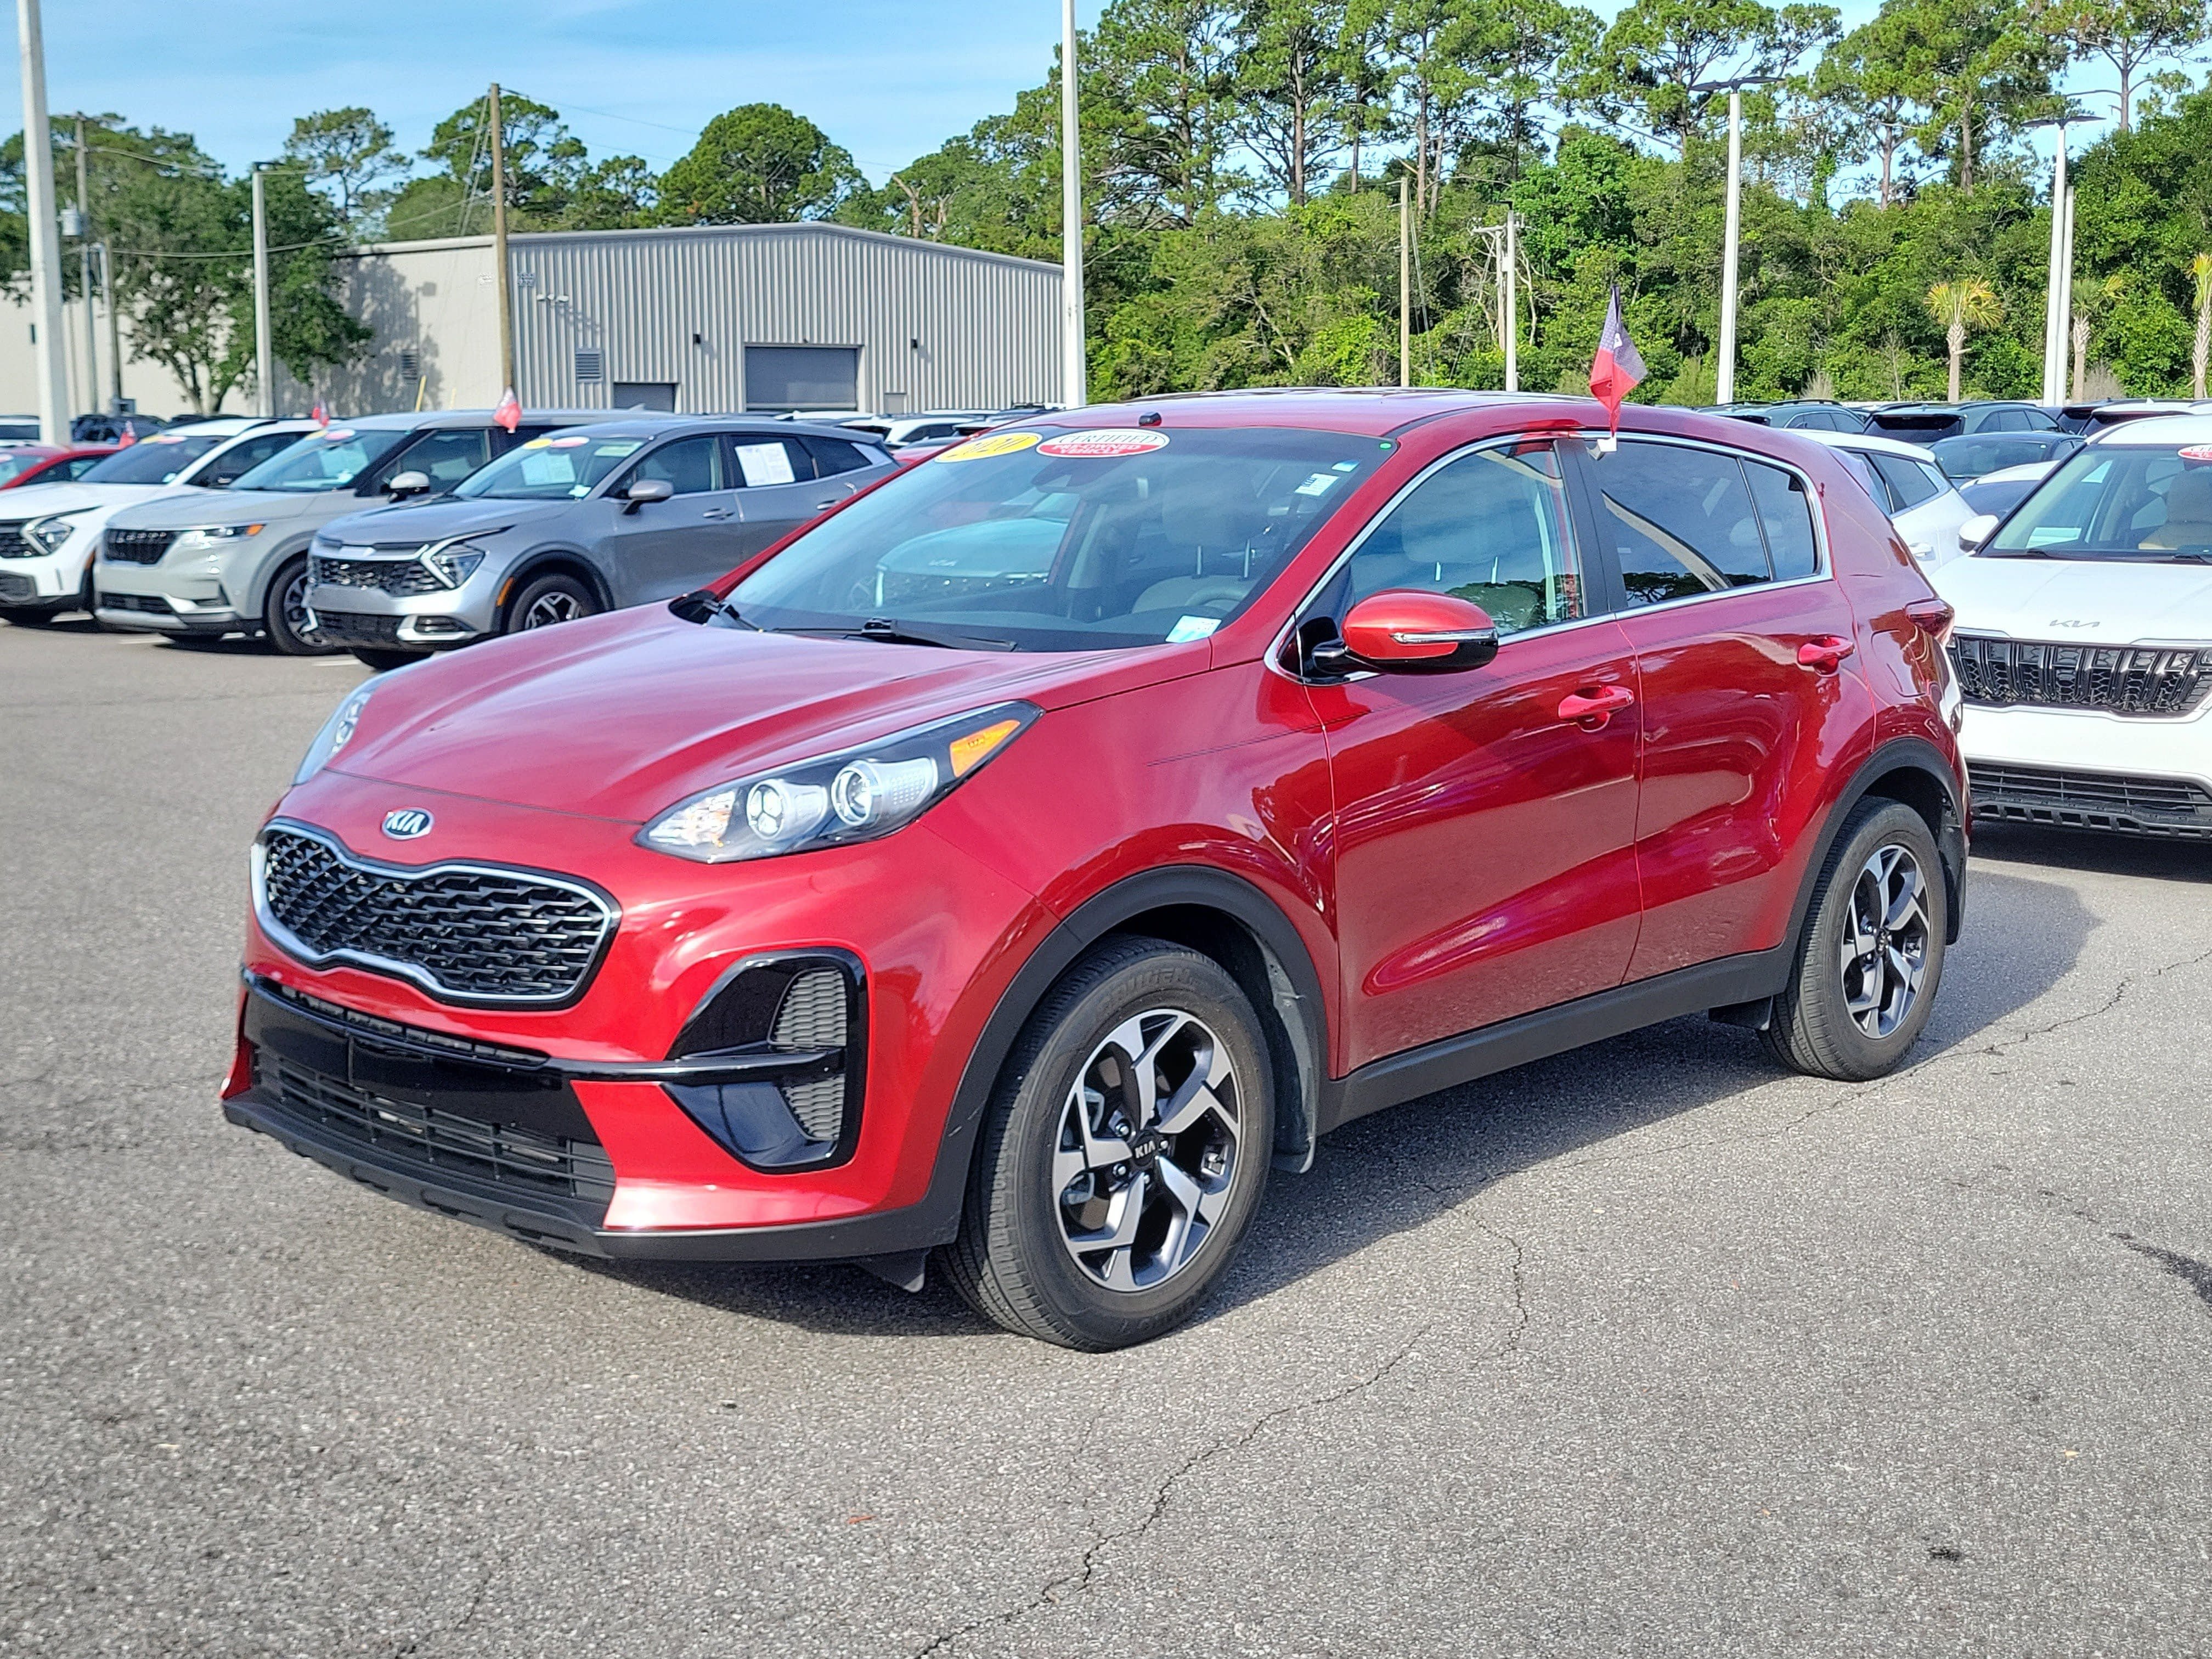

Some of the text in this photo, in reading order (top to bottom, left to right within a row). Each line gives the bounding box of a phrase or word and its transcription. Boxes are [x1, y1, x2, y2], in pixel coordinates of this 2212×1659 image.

[1058, 435, 1158, 444] CERTIFIED
[386, 811, 426, 834] KIA
[1135, 1140, 1156, 1159] KIA
